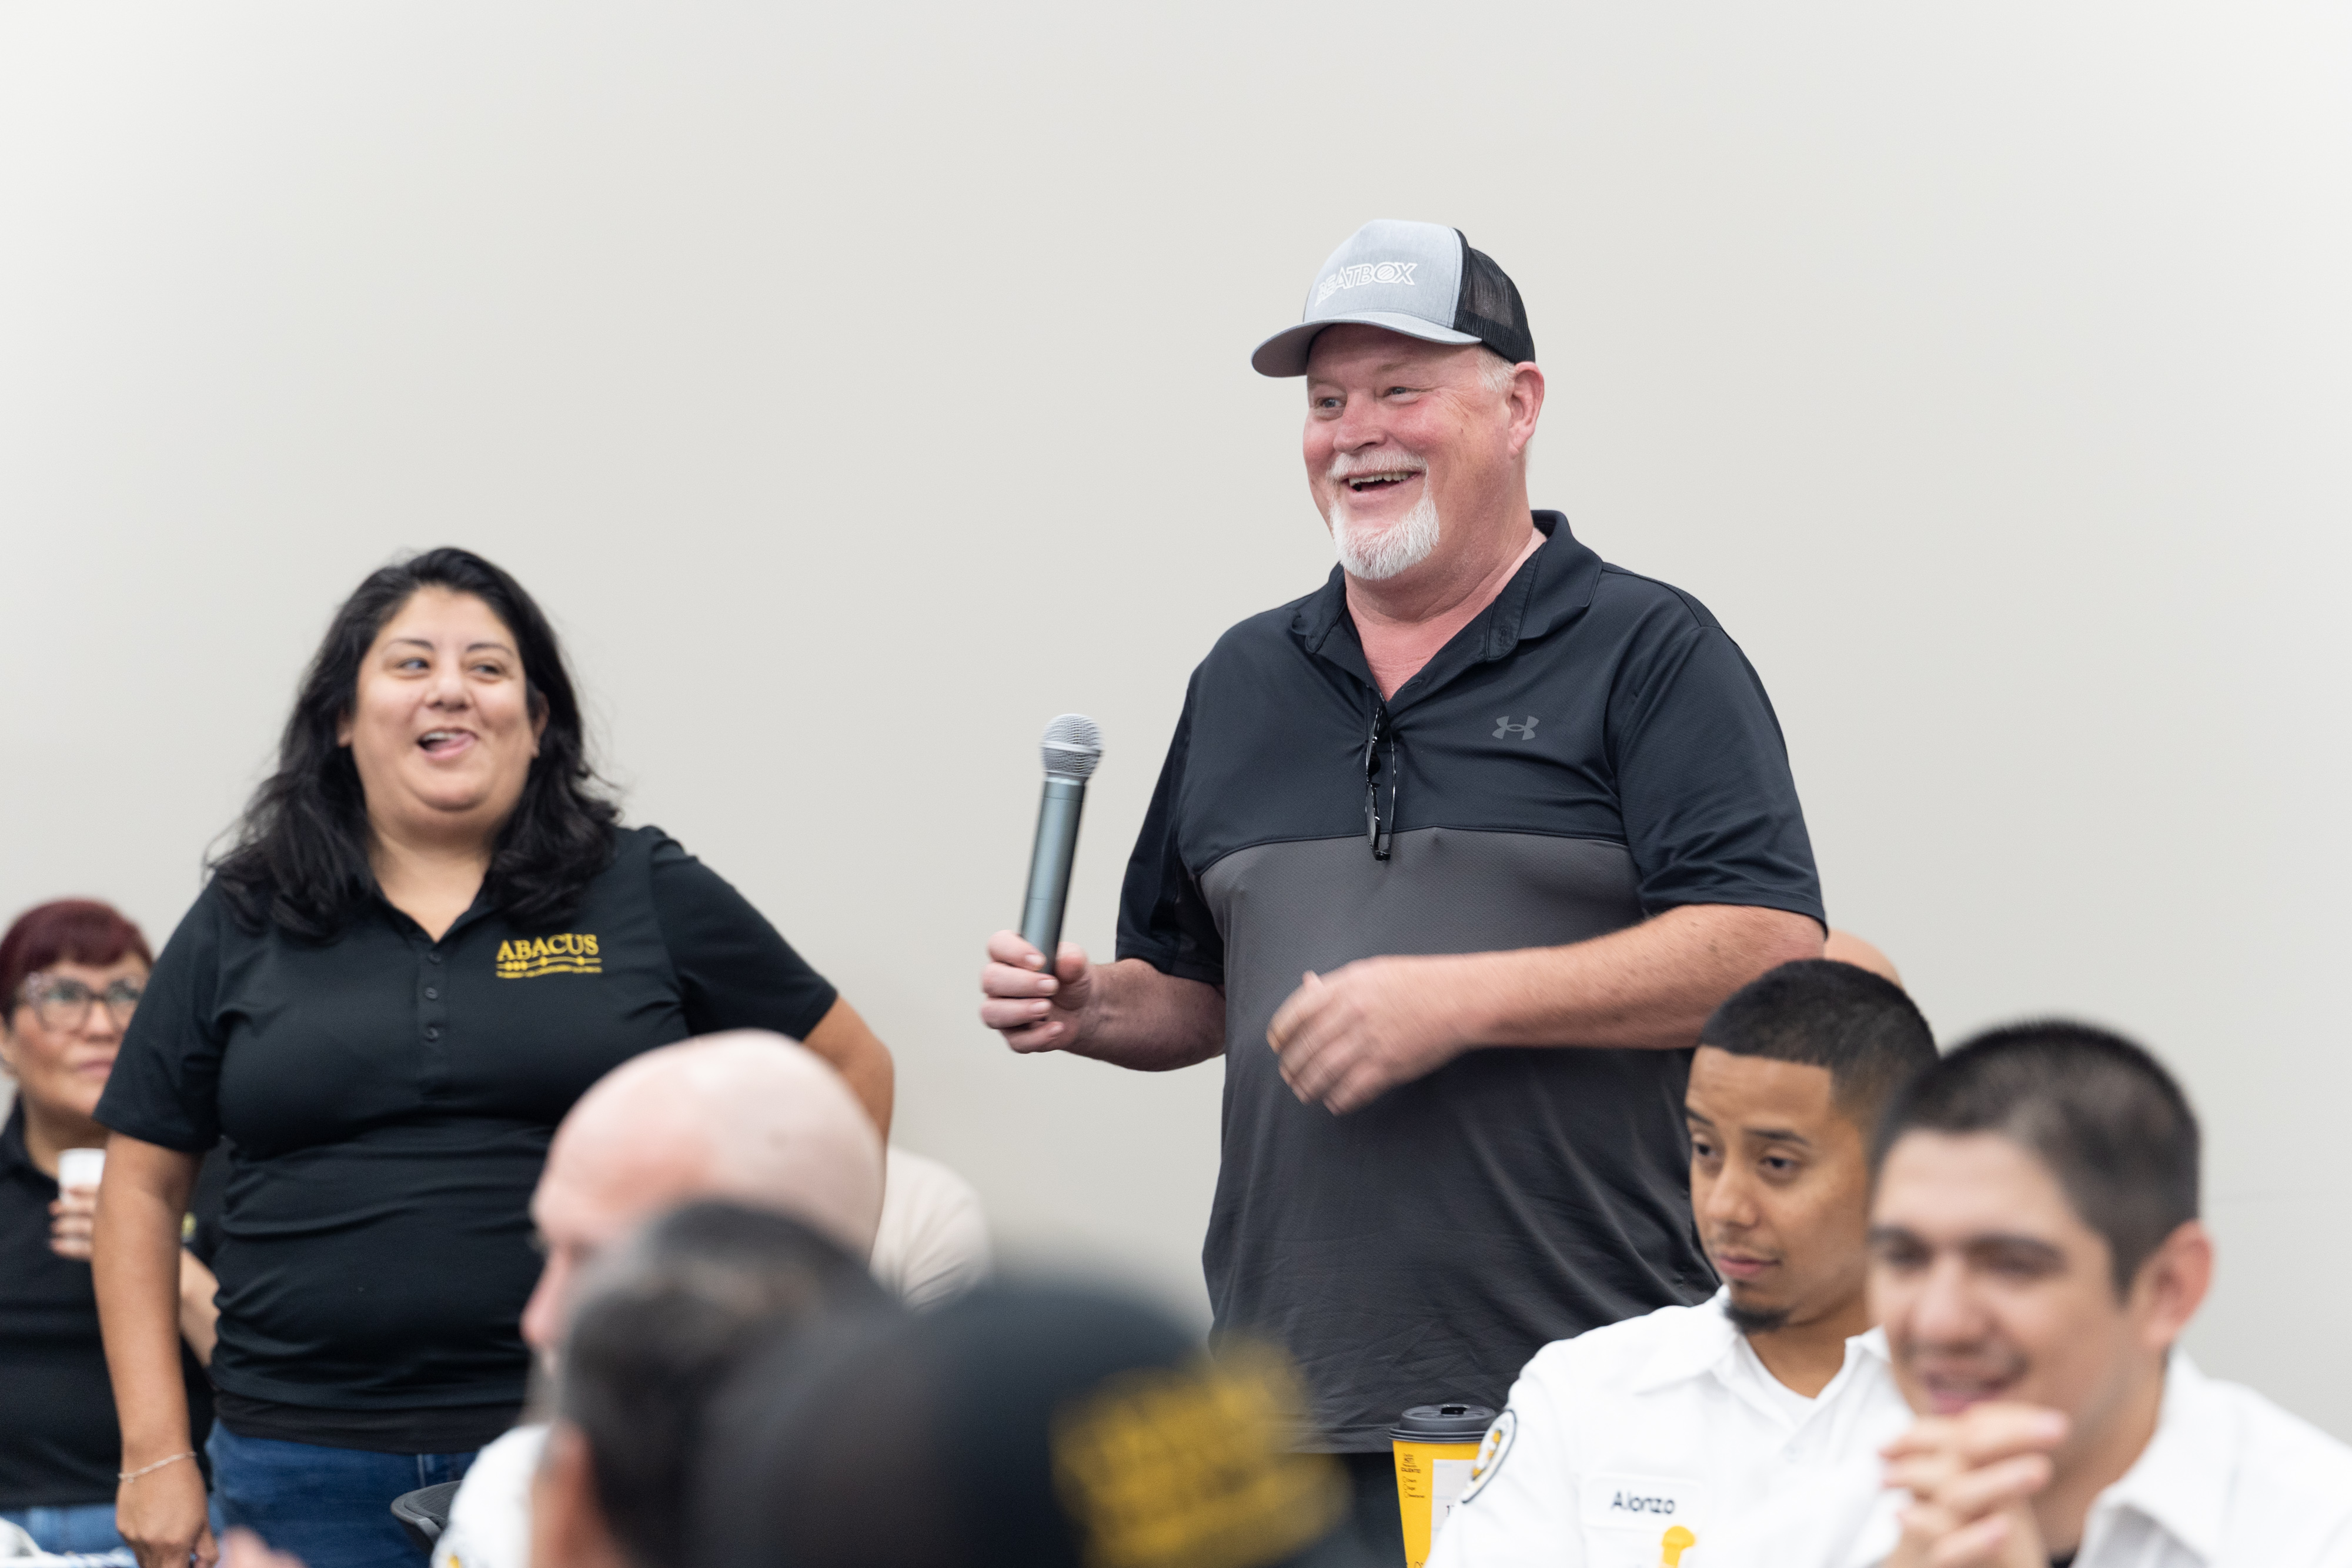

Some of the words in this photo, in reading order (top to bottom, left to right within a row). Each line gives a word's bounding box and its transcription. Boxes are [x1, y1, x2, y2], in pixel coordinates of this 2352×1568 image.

[1315, 262, 1418, 307] BEATBOX
[496, 933, 599, 962] ABACUS
[1610, 1490, 1676, 1514] Alonzo
